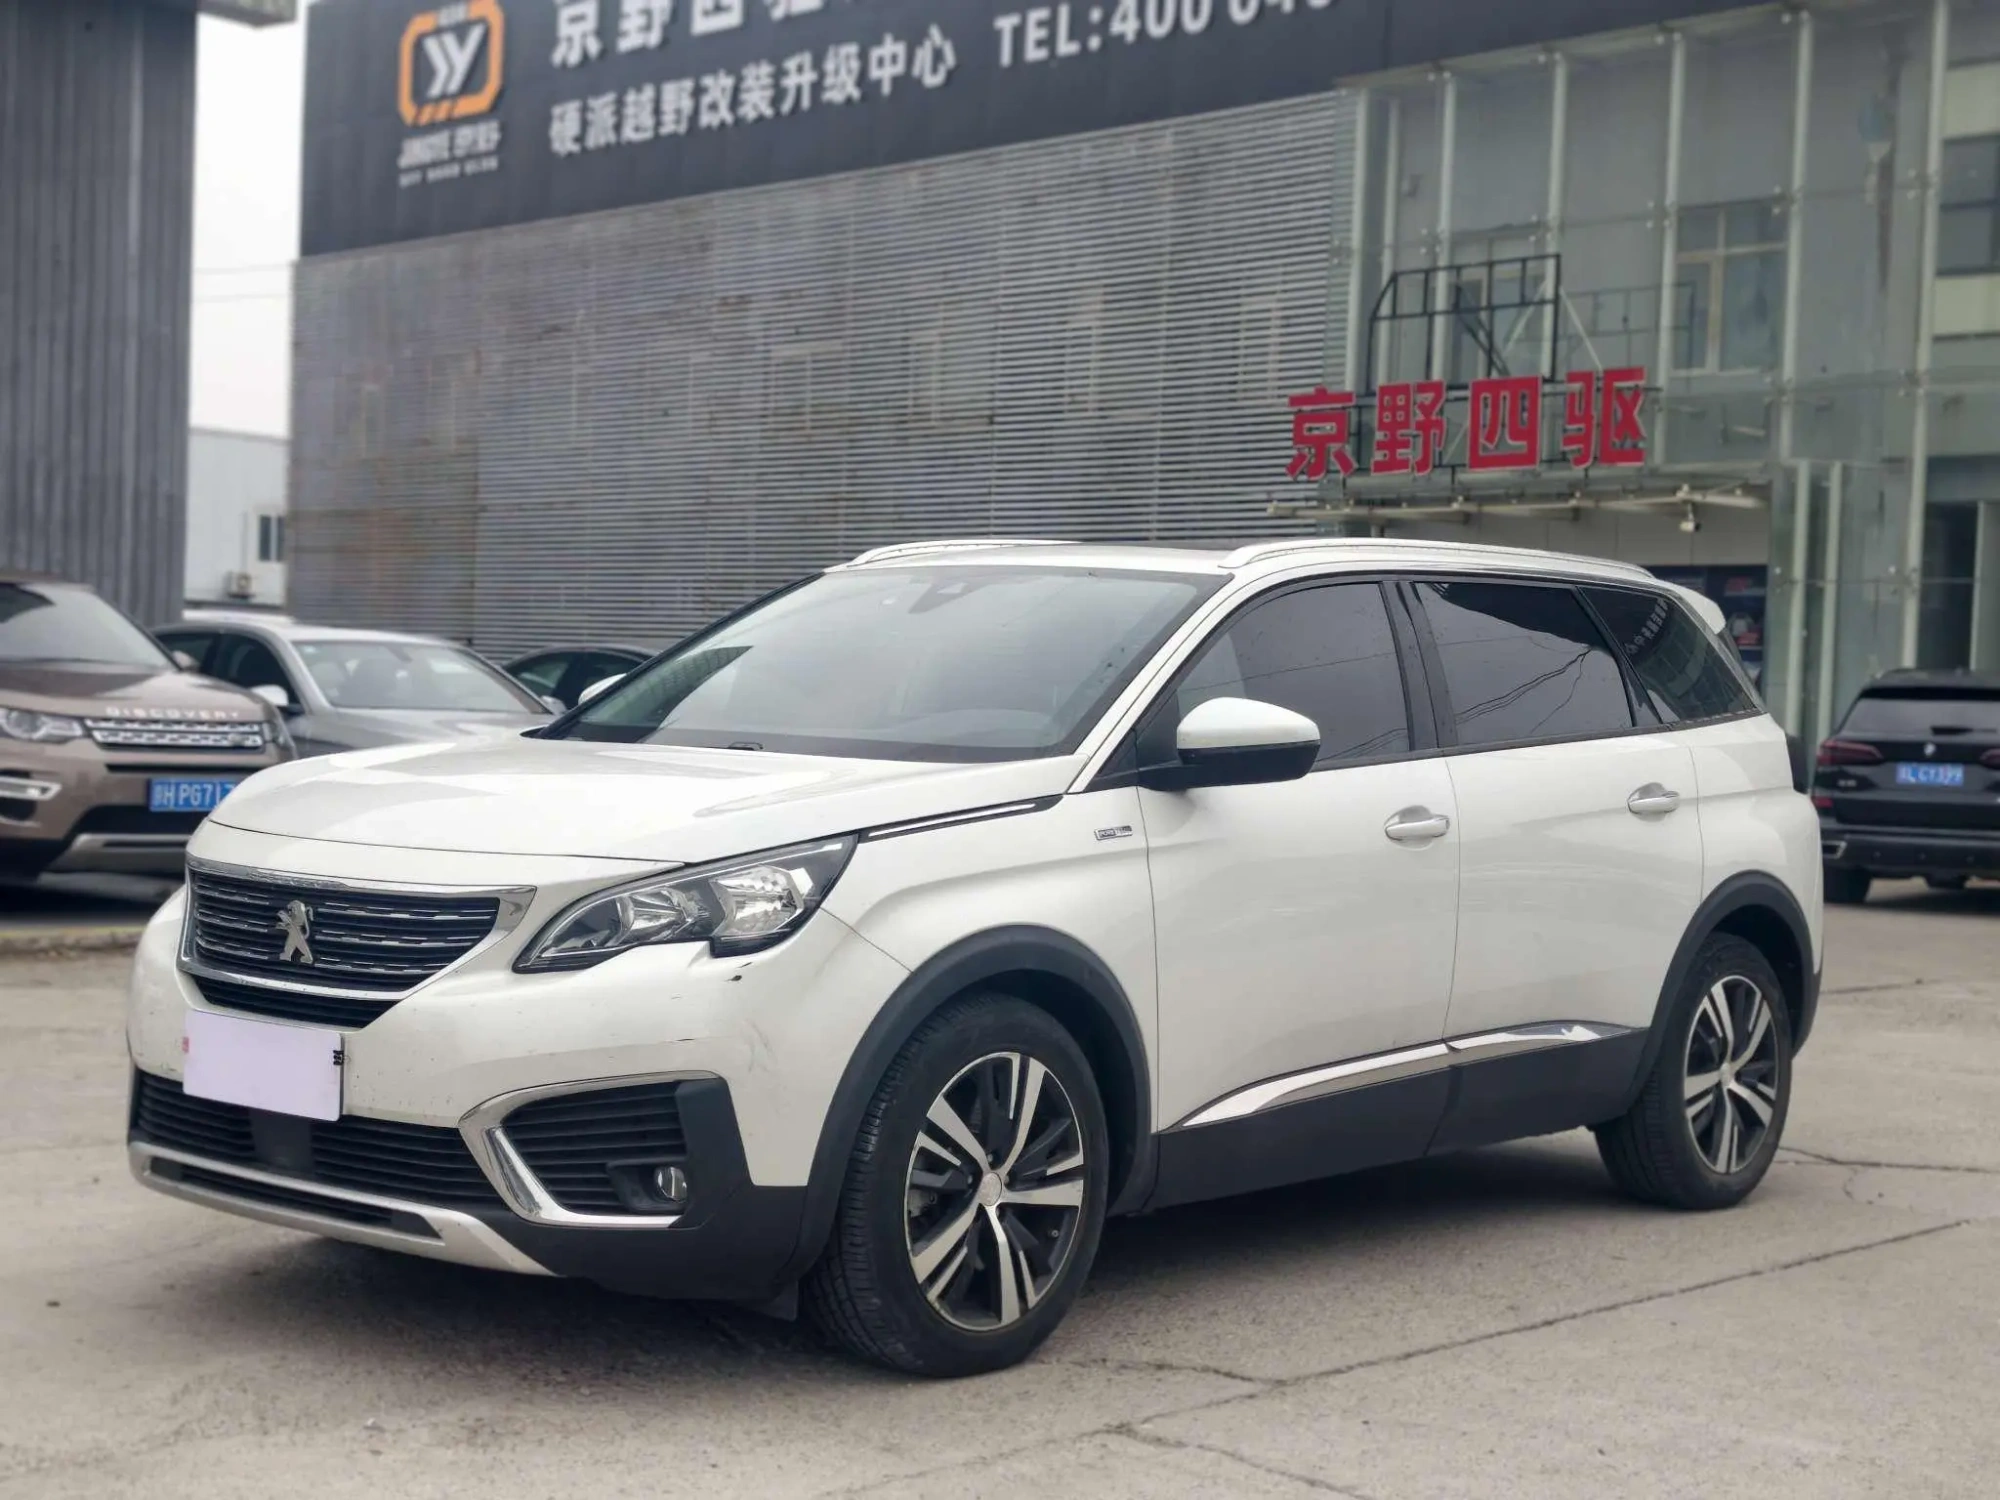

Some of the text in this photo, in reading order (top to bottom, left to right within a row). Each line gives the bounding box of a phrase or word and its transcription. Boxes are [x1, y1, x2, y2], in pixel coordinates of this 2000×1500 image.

[549, 22, 956, 157] 硬派越野改装升级中心
[1285, 366, 1648, 480] 京野四驱
